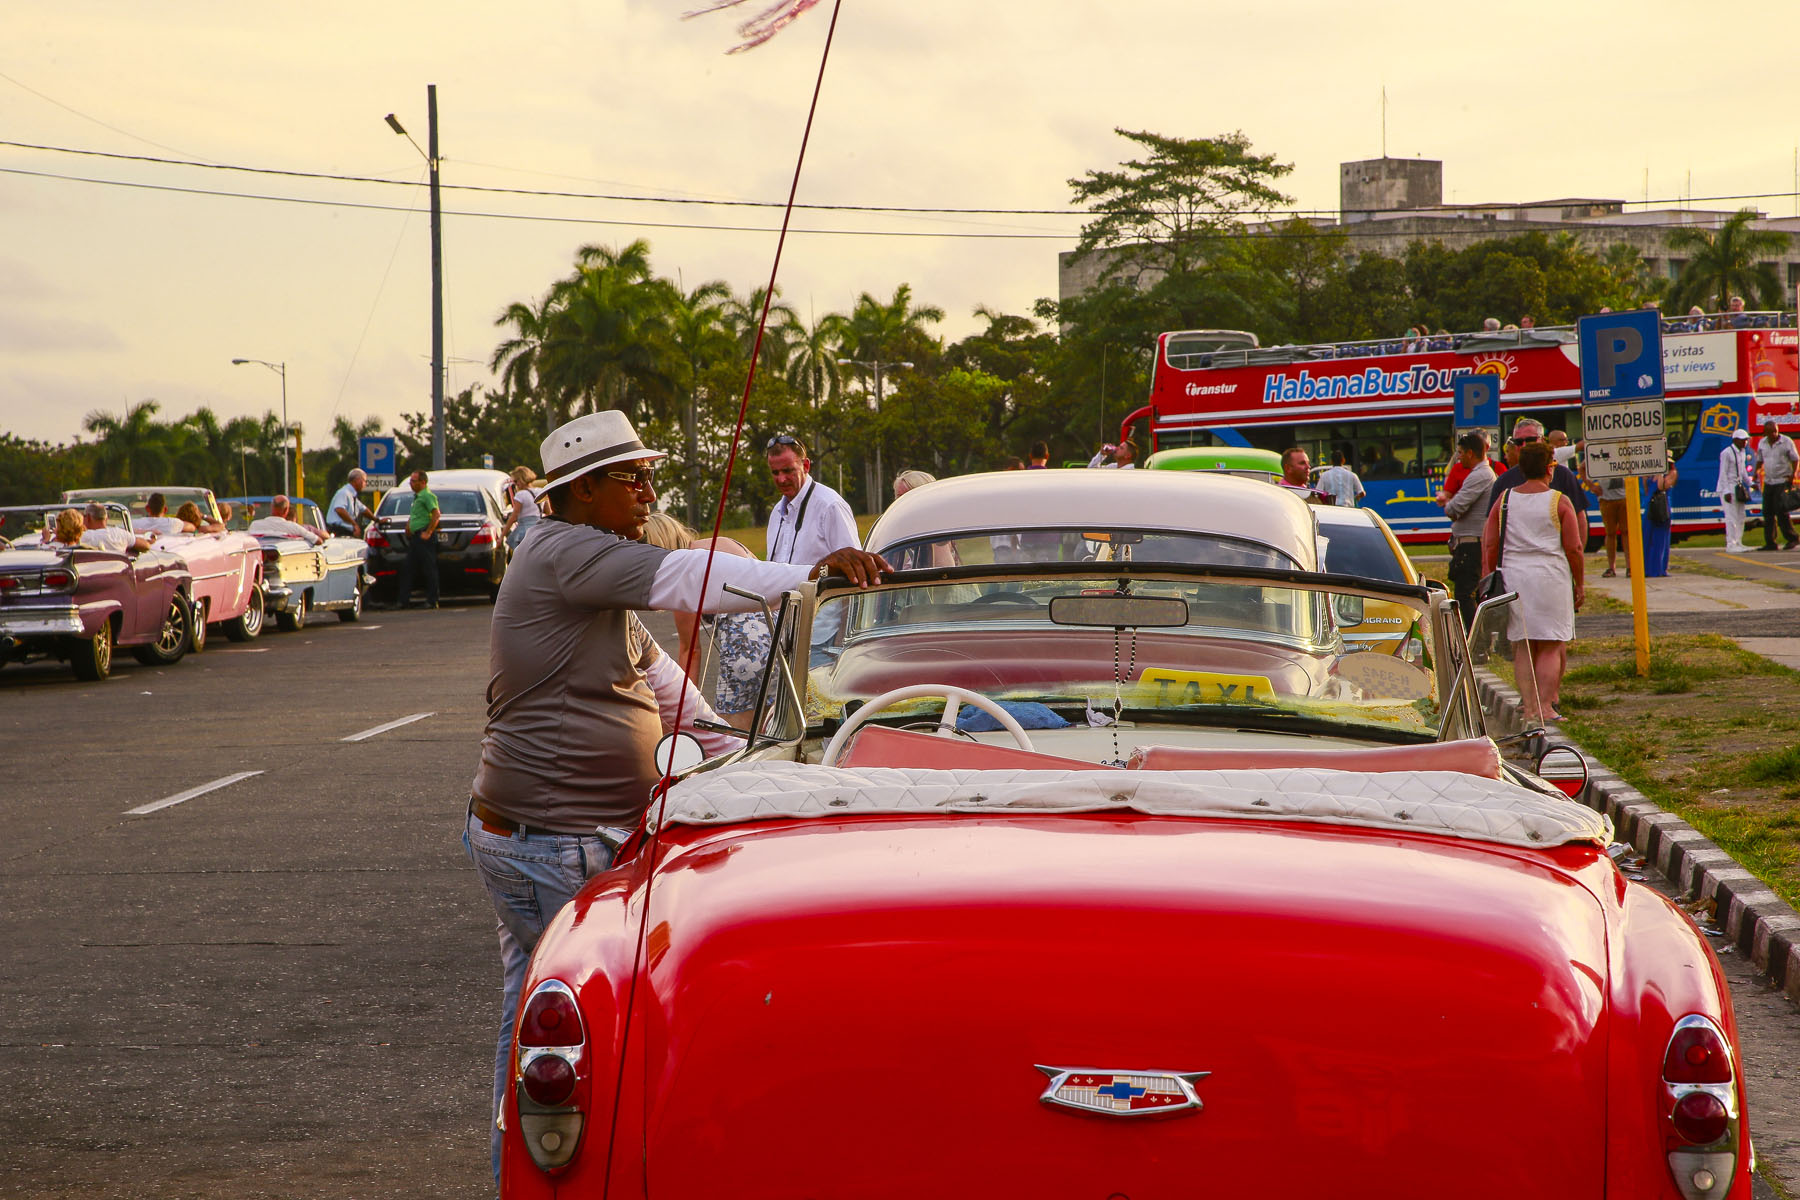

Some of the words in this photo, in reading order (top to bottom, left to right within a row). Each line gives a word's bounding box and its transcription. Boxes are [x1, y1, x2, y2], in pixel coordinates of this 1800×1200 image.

[1596, 327, 1643, 388] P
[1672, 345, 1705, 358] vistas
[1683, 361, 1716, 373] views
[1464, 383, 1490, 419] P
[1587, 410, 1662, 431] MICROBUS
[366, 443, 388, 470] P
[1618, 446, 1642, 457] COCHES
[1644, 445, 1653, 455] DE
[1641, 459, 1664, 469] ANIMAL
